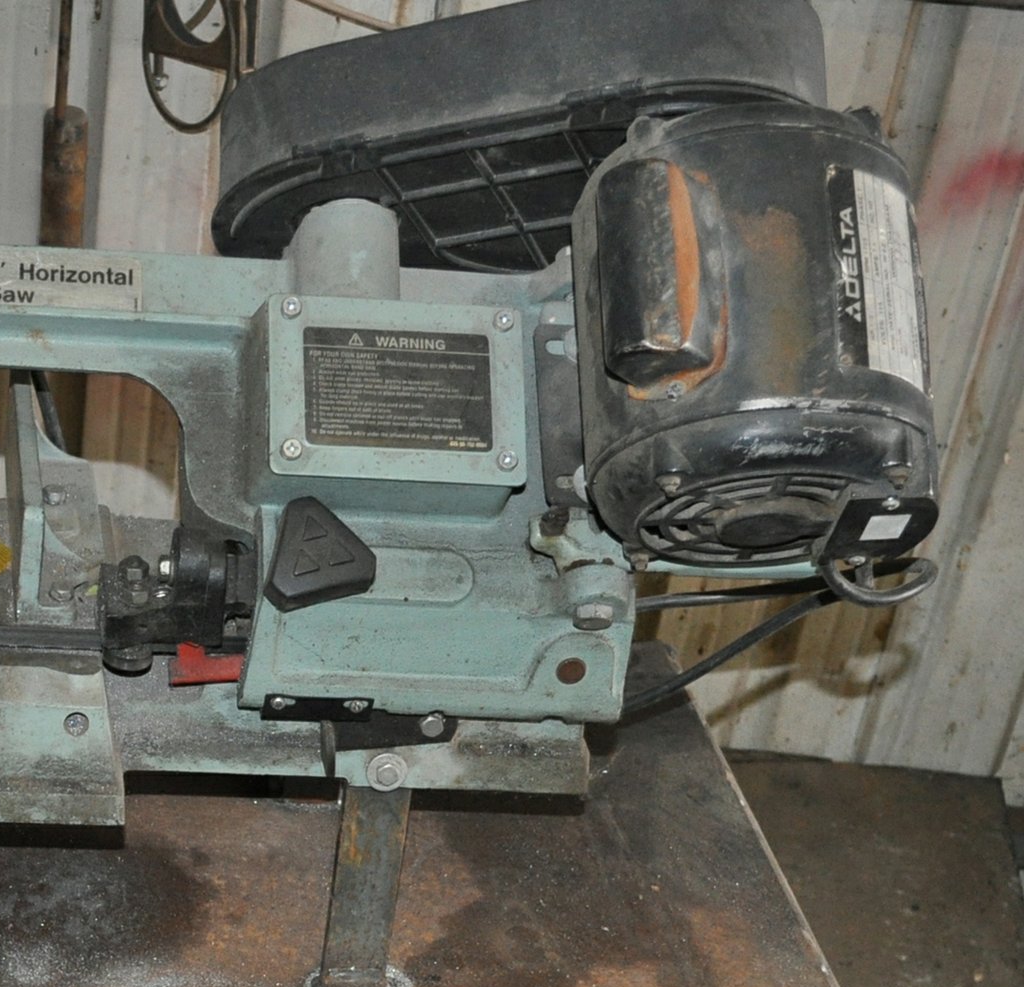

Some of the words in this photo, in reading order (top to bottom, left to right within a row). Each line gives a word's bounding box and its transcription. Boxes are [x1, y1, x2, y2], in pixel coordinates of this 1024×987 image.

[839, 206, 860, 299] DELTA
[18, 262, 134, 287] Horizontal
[375, 336, 446, 351] WARNING
